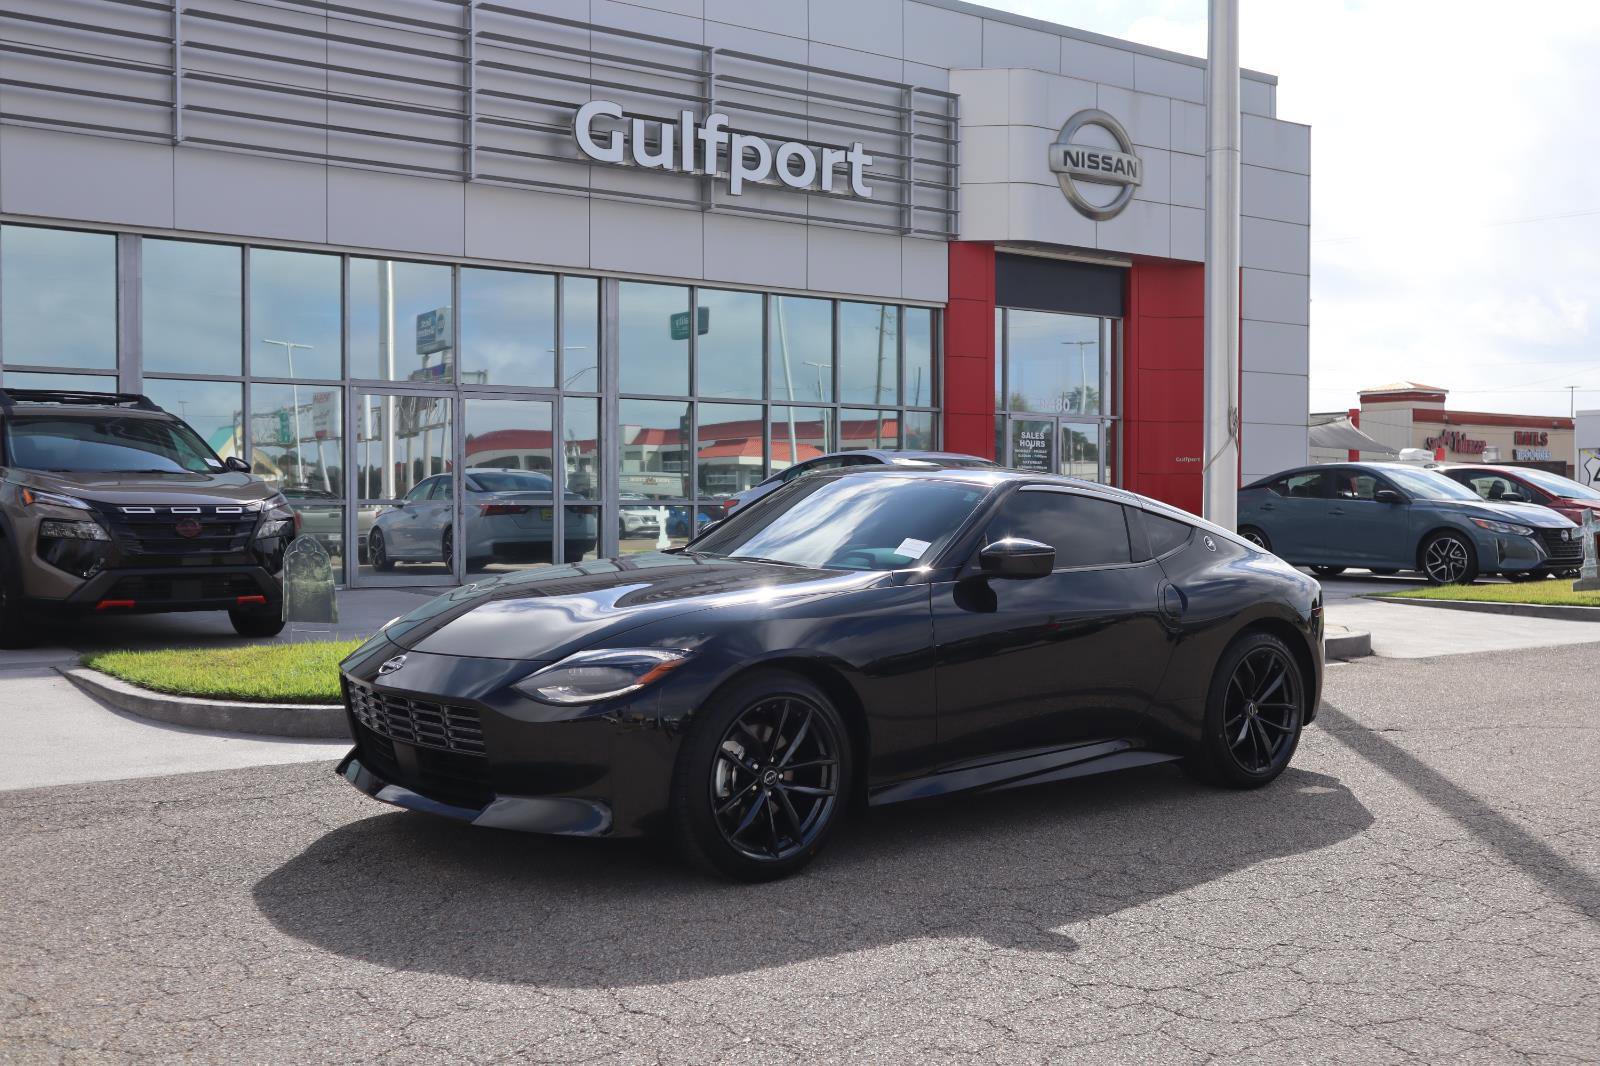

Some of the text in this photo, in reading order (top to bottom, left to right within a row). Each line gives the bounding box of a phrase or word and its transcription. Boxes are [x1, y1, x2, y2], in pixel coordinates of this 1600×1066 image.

[574, 100, 873, 198] Gulfport
[1063, 150, 1137, 178] NISSAN
[1019, 439, 1046, 448] HOURS
[1021, 431, 1045, 440] SALES
